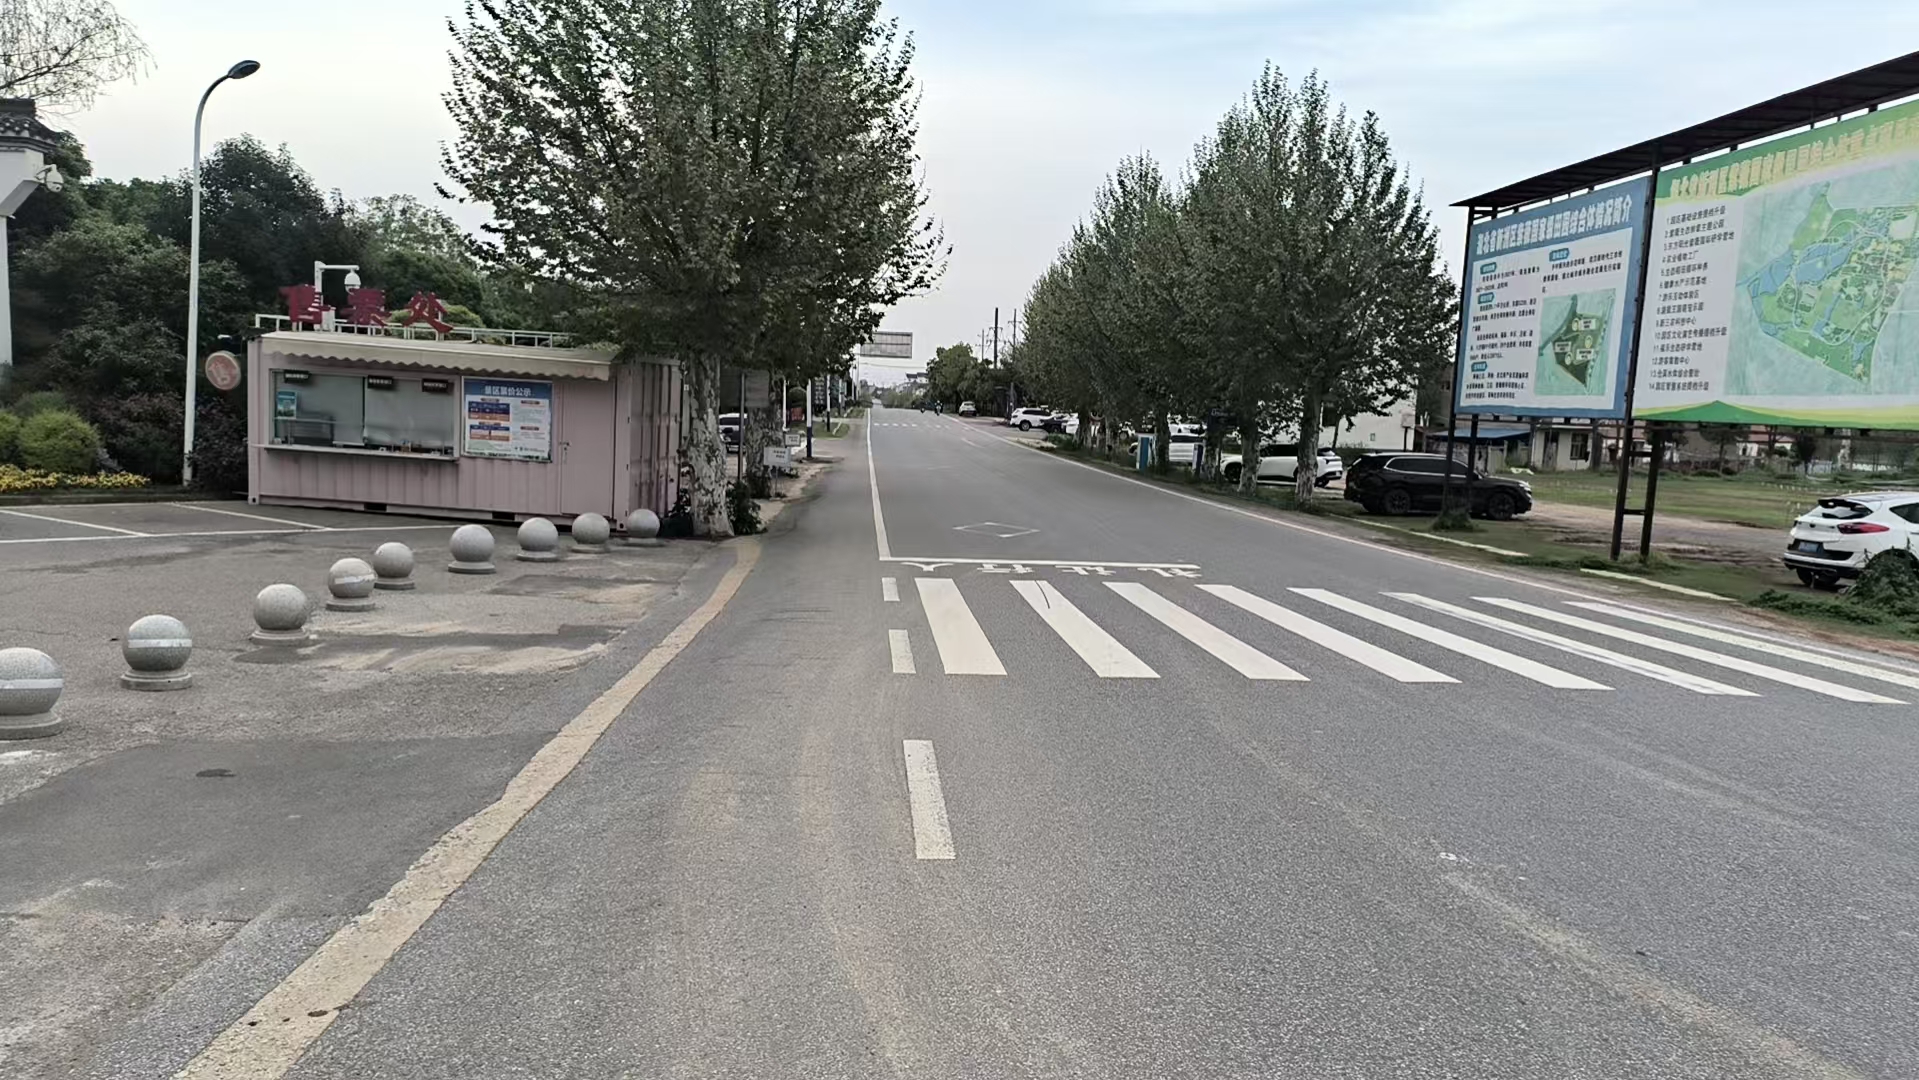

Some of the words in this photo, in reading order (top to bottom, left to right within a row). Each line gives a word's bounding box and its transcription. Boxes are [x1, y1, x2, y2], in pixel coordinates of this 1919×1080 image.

[279, 284, 454, 333] 售票处
[485, 385, 532, 397] 景区票价公示
